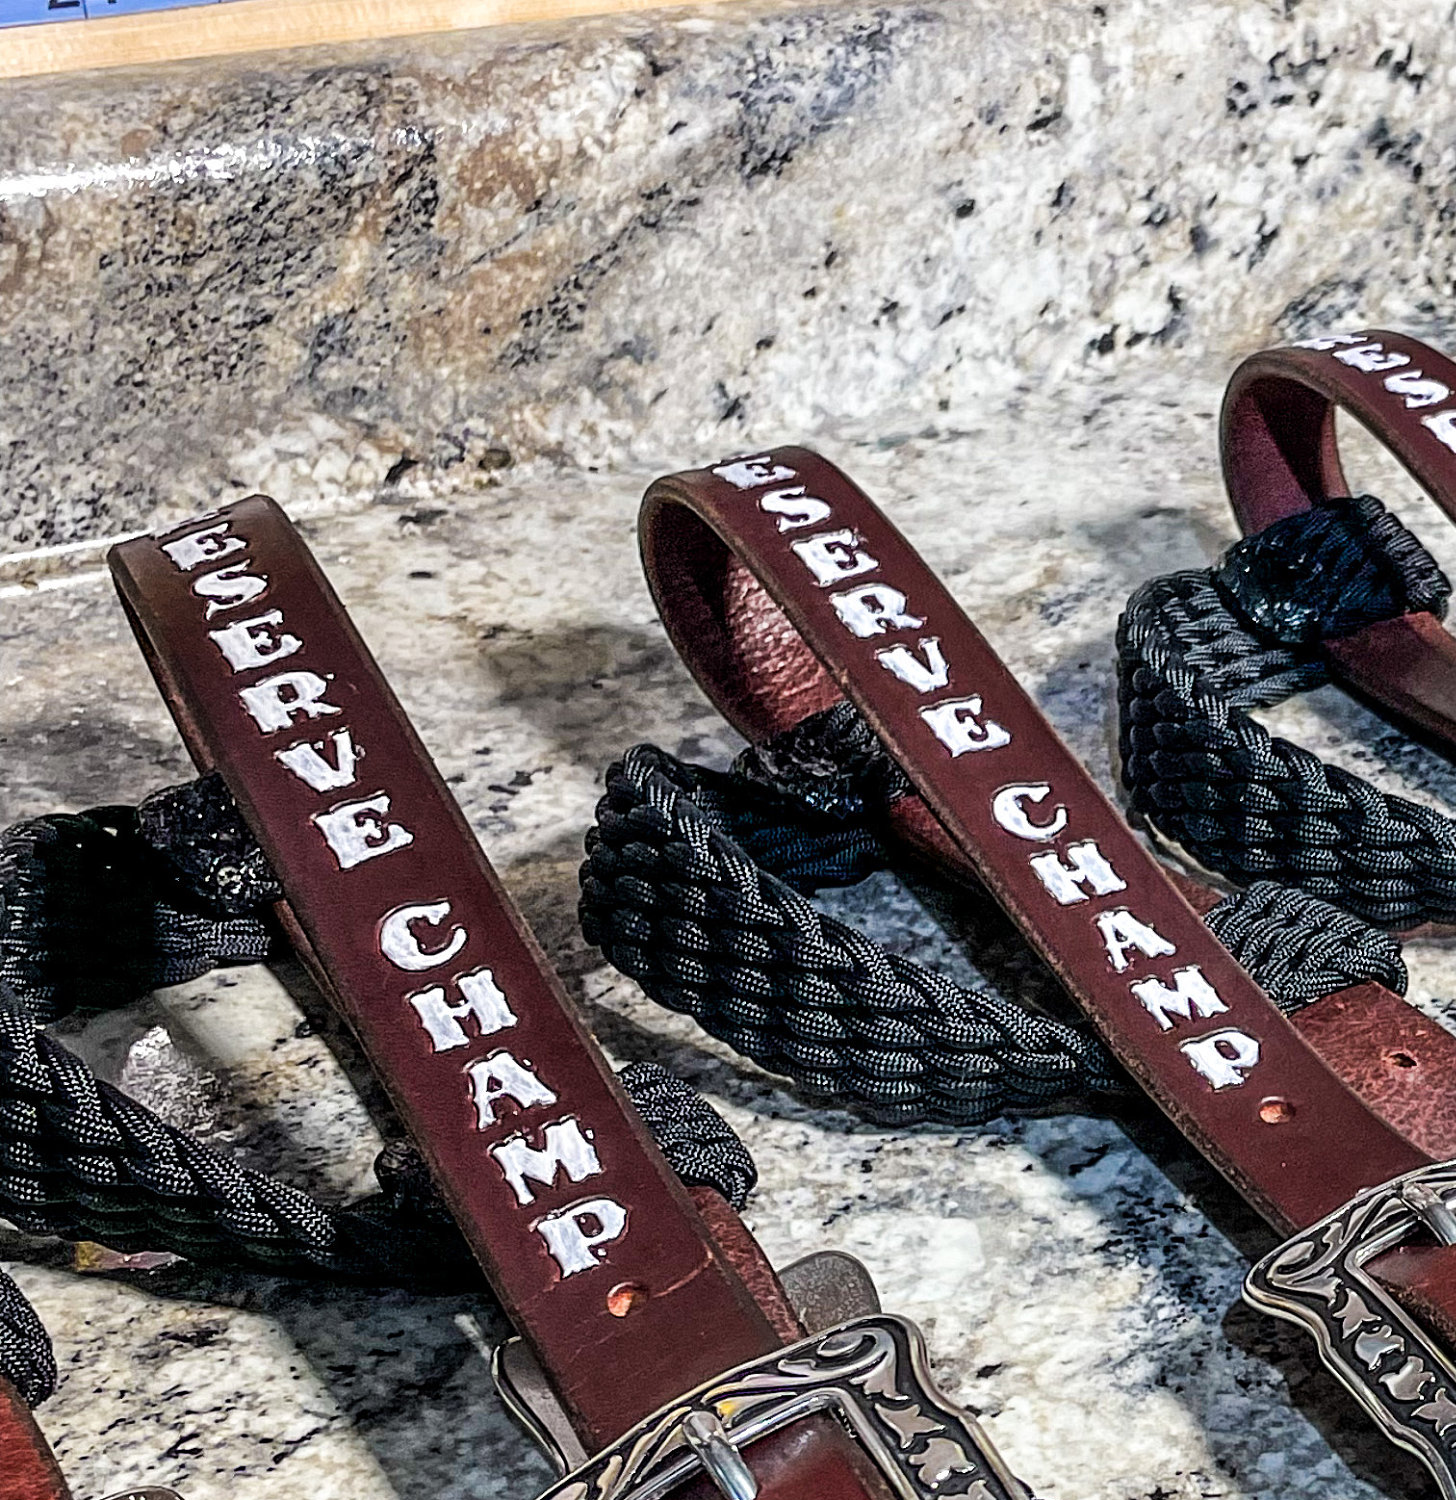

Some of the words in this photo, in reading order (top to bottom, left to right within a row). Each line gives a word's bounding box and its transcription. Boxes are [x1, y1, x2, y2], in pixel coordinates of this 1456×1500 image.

[156, 511, 414, 870] ESERVE
[378, 897, 629, 1280] CHAMP
[712, 455, 1012, 758] ESERVE
[991, 782, 1262, 1092] CHAMP
